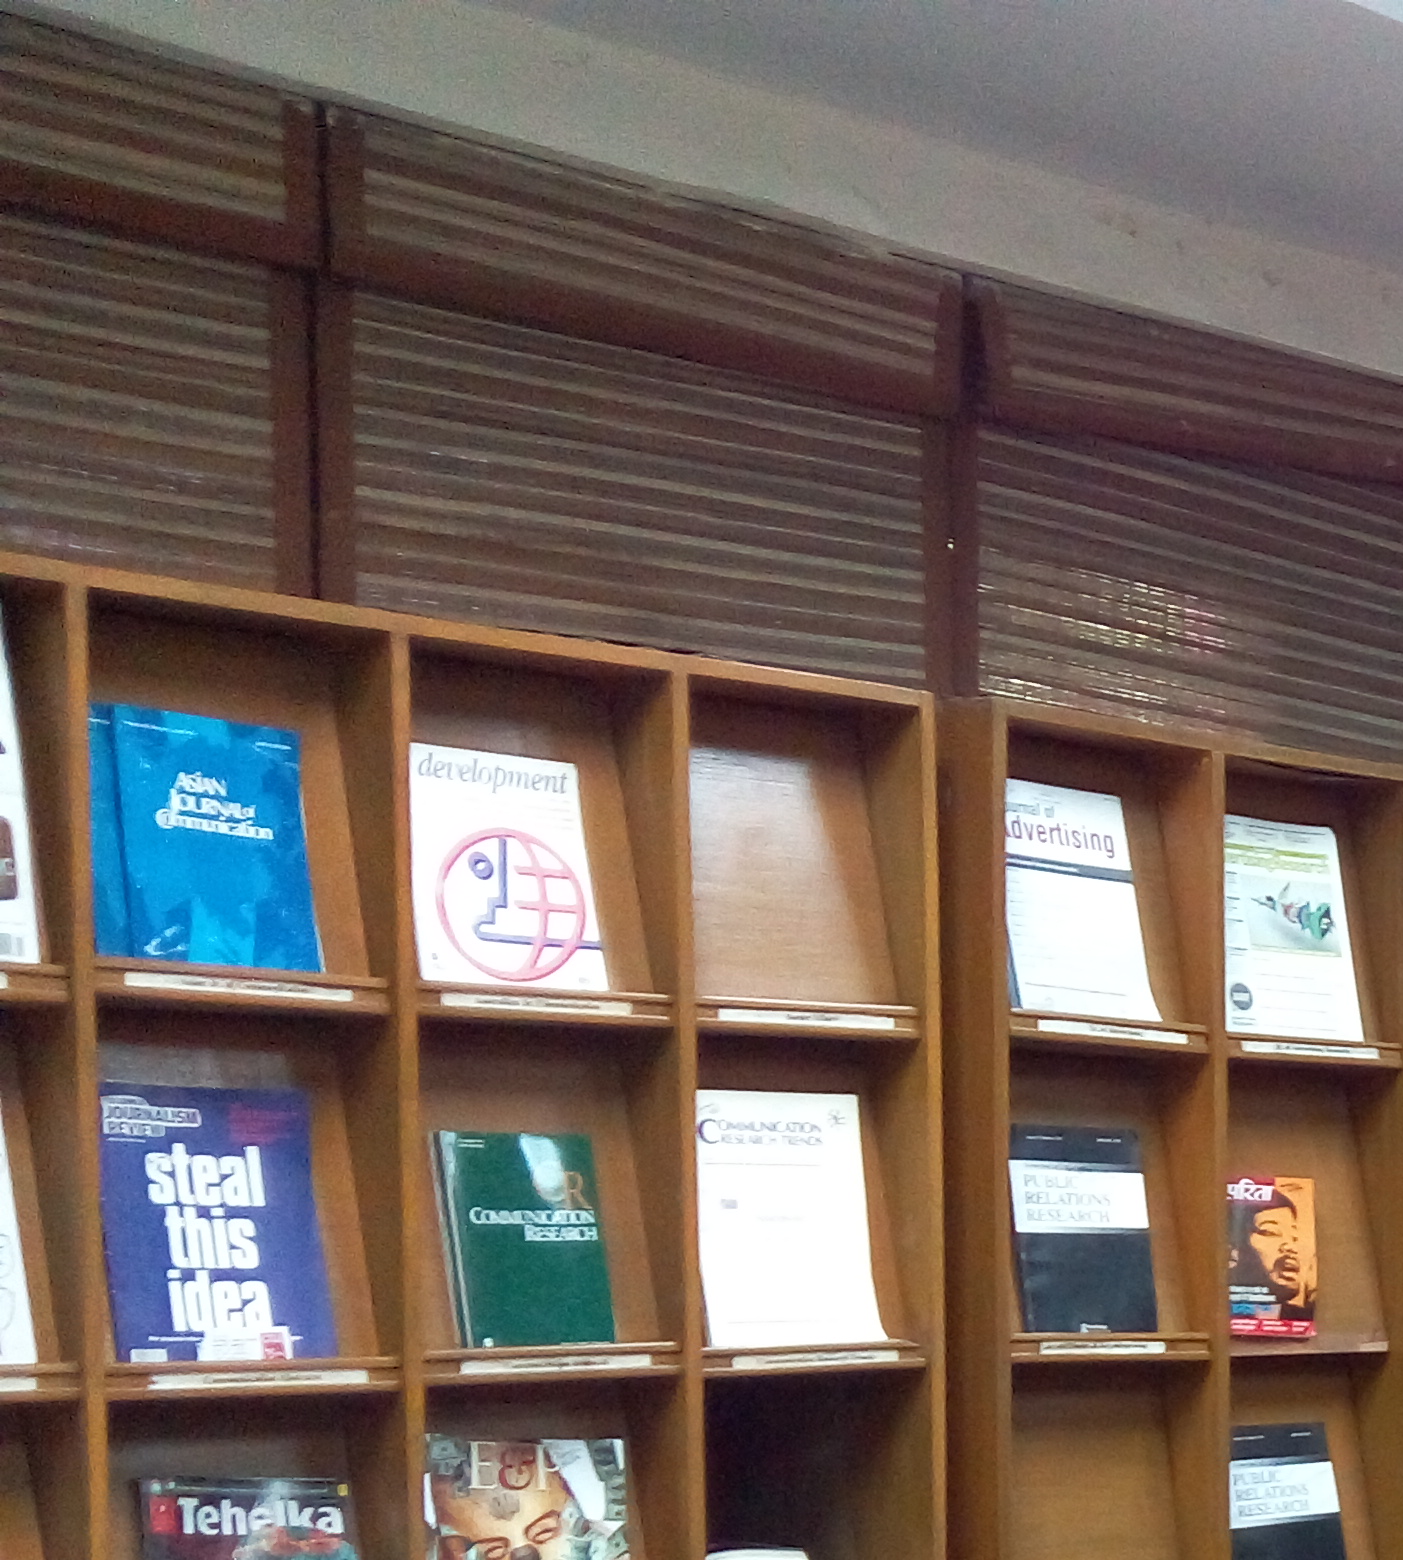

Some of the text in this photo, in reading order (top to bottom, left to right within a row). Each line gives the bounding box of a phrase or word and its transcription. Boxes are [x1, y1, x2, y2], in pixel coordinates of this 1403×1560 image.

[417, 751, 570, 795] development
[173, 771, 228, 797] ASIAN
[698, 1118, 823, 1144] COMMUNICATION
[145, 1143, 266, 1207] steal
[1024, 1173, 1077, 1190] PUBLIC
[1024, 1189, 1111, 1208] RELATIONS
[470, 1207, 597, 1225] COMMUNICATION
[1026, 1207, 1110, 1224] RESEARCH
[164, 1205, 260, 1269] this
[524, 1225, 599, 1242] RESEARCH
[166, 1269, 274, 1332] idea
[1232, 1469, 1282, 1487] PUBLIC
[1235, 1483, 1310, 1503] RELATIONS
[176, 1496, 346, 1536] Tehelka
[1238, 1499, 1310, 1518] RESEARCH
